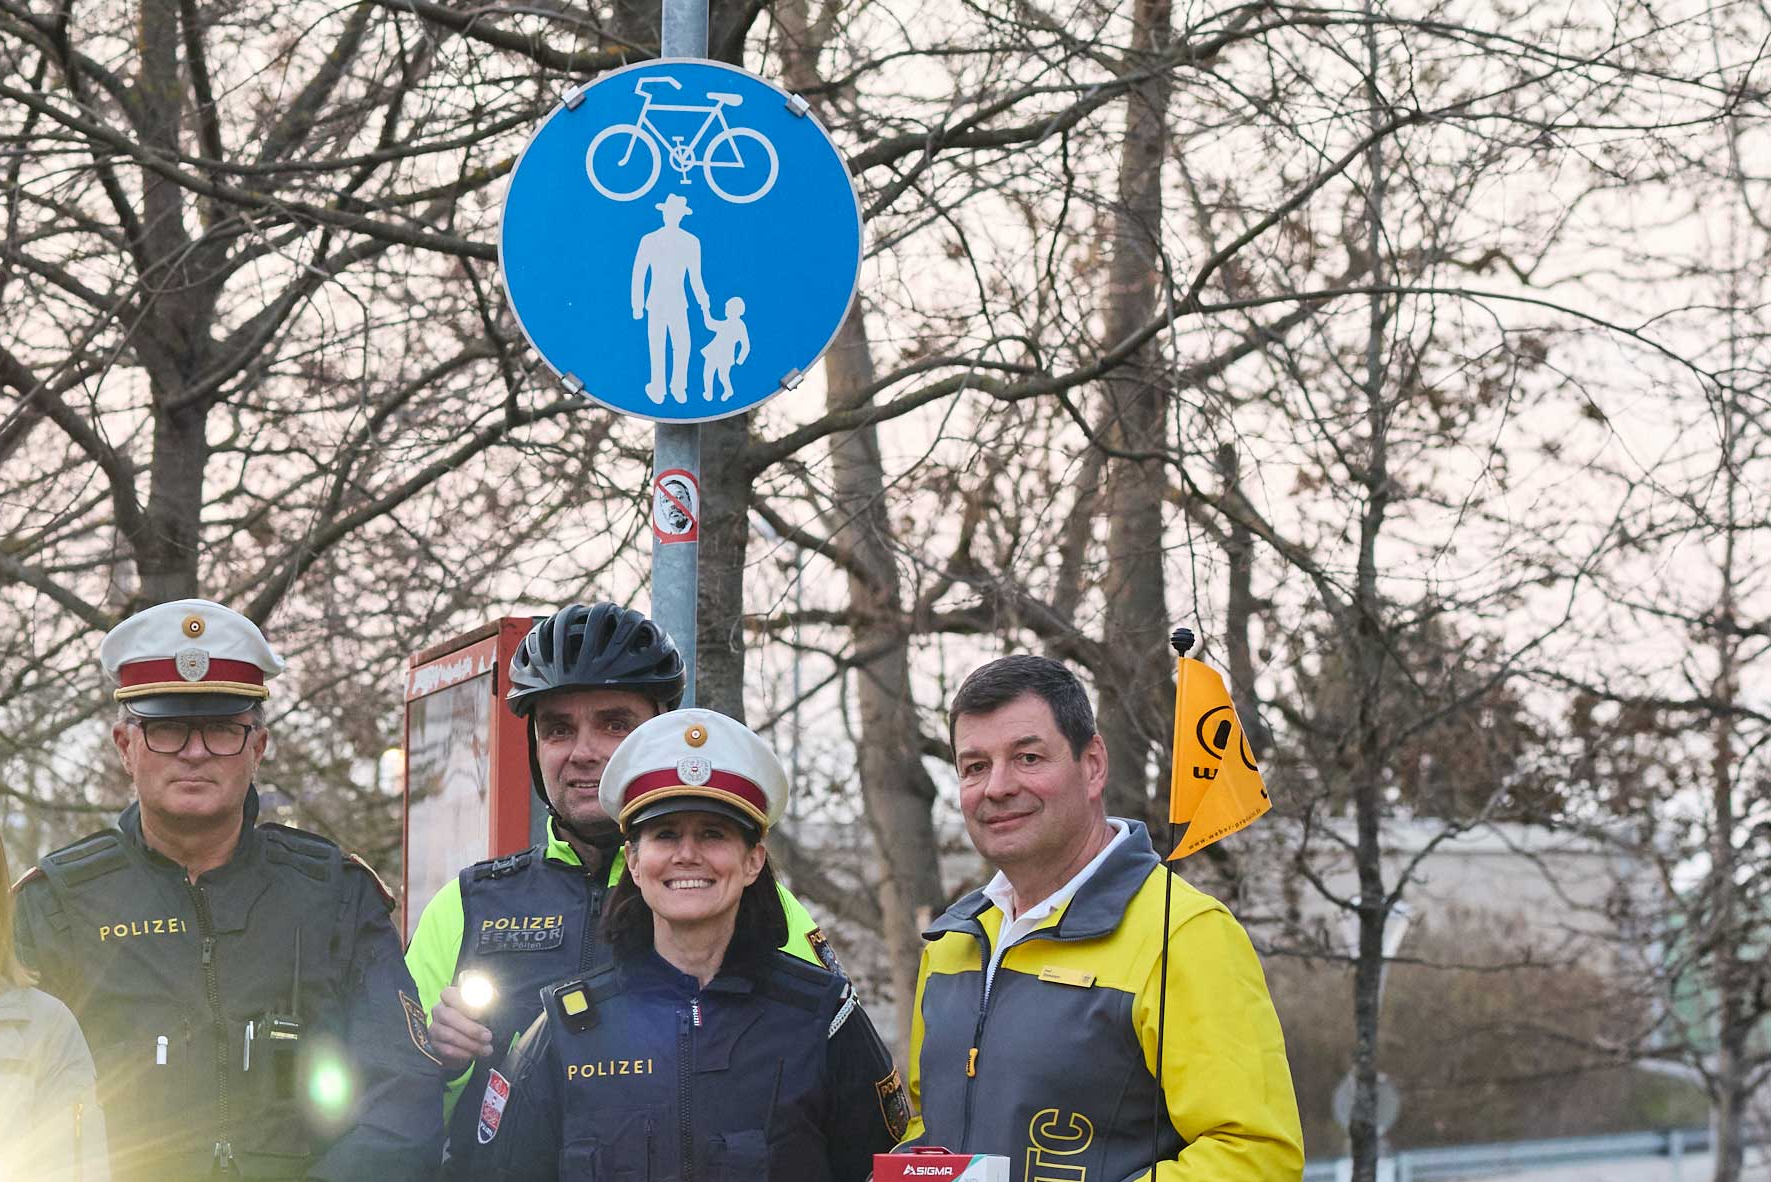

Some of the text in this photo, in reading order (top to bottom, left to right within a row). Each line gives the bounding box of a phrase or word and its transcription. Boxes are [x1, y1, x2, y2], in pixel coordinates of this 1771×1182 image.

[99, 917, 187, 942] POLIZEI
[481, 915, 563, 931] POLIZEI
[481, 928, 561, 944] SEKTOR
[568, 1059, 653, 1080] POLIZEI
